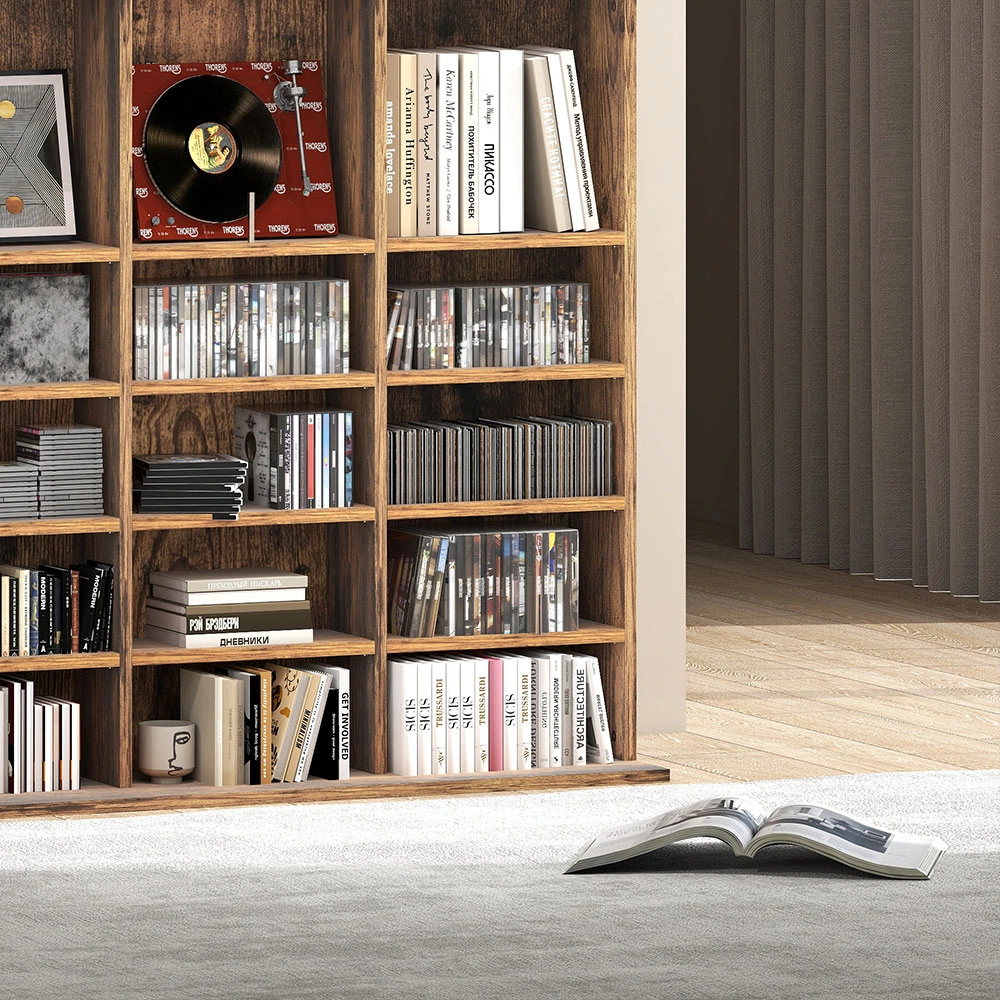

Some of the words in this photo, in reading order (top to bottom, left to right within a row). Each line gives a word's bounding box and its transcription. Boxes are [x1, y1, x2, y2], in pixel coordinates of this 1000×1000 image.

[159, 64, 181, 74] THORENS
[205, 63, 227, 73] THORENS
[251, 63, 272, 72] THORENS
[302, 61, 318, 71] ORENS
[423, 68, 433, 92] The
[445, 69, 455, 96] Karen
[386, 101, 395, 144] amanda
[405, 88, 415, 135] Arianna
[423, 95, 435, 119] body
[540, 96, 559, 147] СПАСИТЕ
[419, 124, 433, 161] beyond
[443, 100, 456, 151] McCartney
[305, 142, 327, 153] THORENS
[467, 125, 475, 180] ПОХИТИТЕЛЬ
[386, 148, 396, 195] lovelace
[403, 139, 415, 205] Huffington
[484, 144, 495, 196] ПИКАССО
[573, 113, 583, 136] Метод
[582, 180, 594, 218] проектами
[467, 181, 475, 219] БАБОЧЕК
[177, 227, 198, 237] THORENS
[223, 226, 244, 236] THORENS
[268, 225, 290, 235] THORENS
[314, 223, 336, 233] THORENS
[89, 575, 101, 609] MODERN
[189, 617, 203, 632] РЭЙ
[205, 616, 240, 632] БРЭДБЕРИ
[220, 636, 270, 647] ДНЕВНИКИ
[341, 692, 349, 710] GET
[405, 698, 416, 732] SICIS
[419, 698, 430, 731] SICIS
[435, 678, 443, 728] TRUSSARDI
[448, 696, 459, 730] SICIS
[462, 695, 473, 729] SICIS
[478, 676, 486, 726] TRUSSARDI
[505, 693, 516, 727] SICIS
[521, 674, 529, 724] TRUSSARDI
[295, 709, 311, 750] MINIMALISM
[341, 712, 349, 760] INVOLVED
